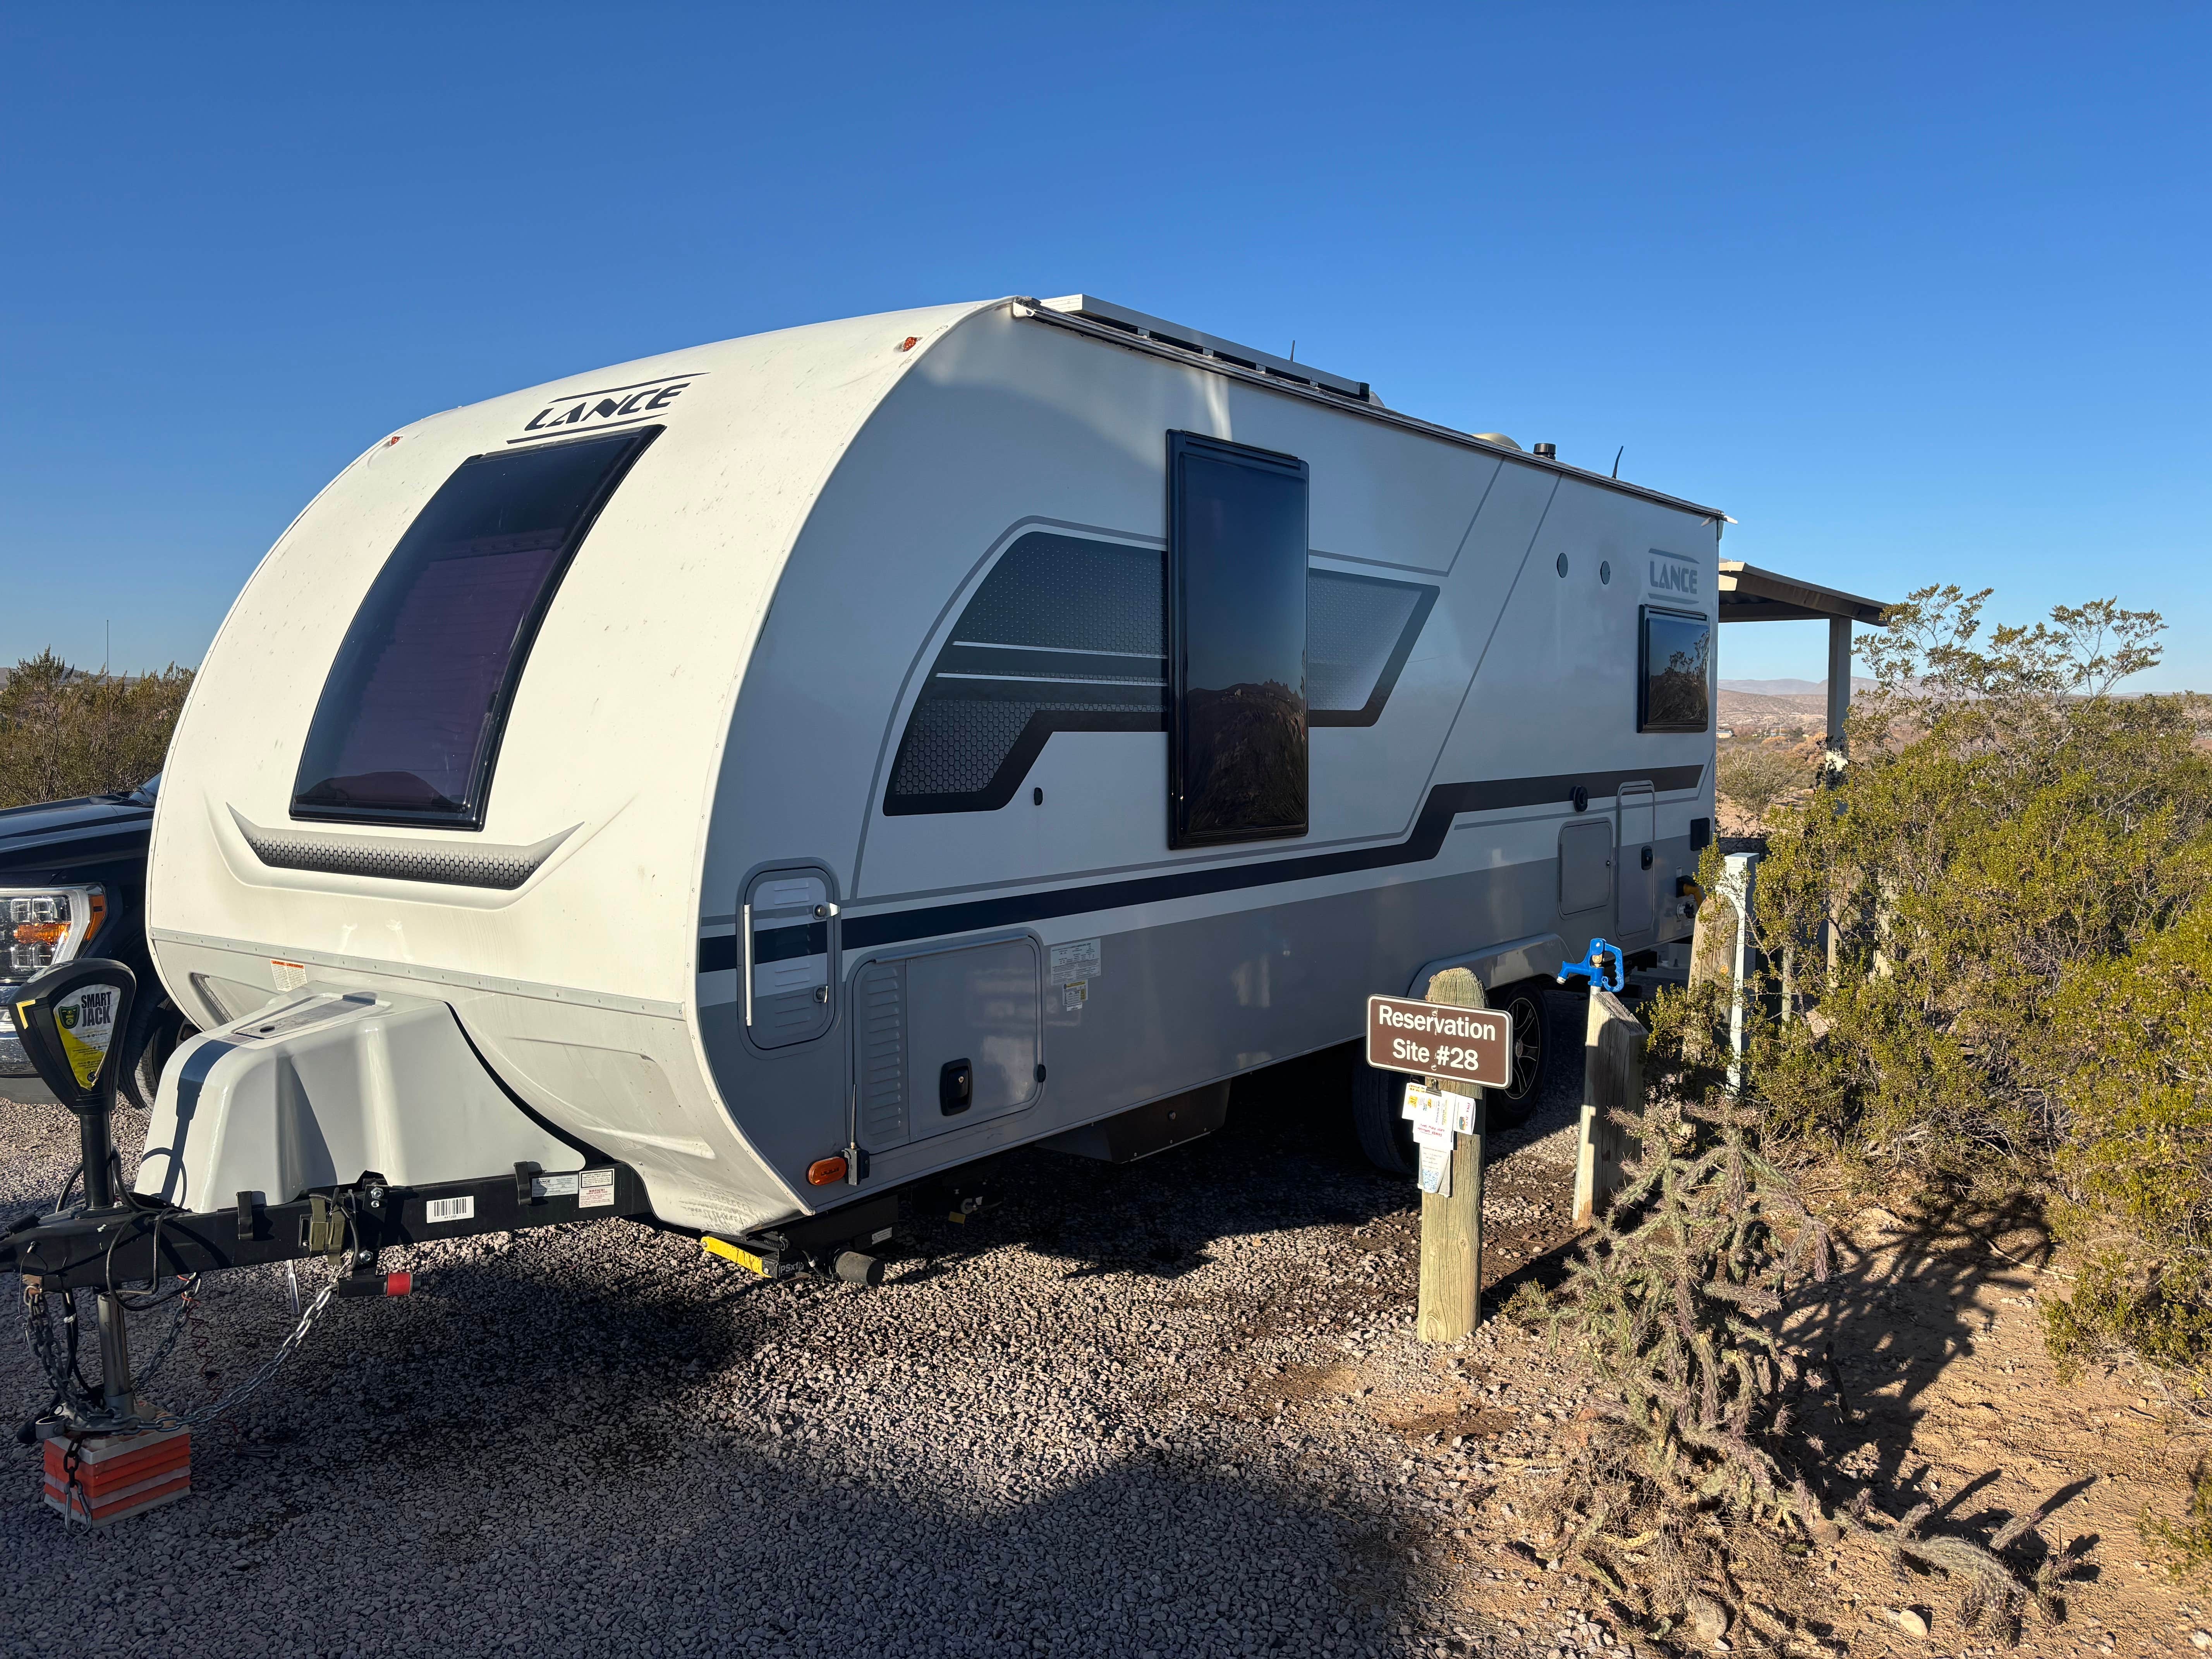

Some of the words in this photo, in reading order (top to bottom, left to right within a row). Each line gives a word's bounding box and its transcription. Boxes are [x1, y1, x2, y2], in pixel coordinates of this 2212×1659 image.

[524, 382, 691, 431] LANCE
[1650, 561, 1697, 594] LANCE
[81, 991, 112, 1009] SMART
[82, 1006, 111, 1027] JACK
[1379, 1005, 1496, 1041] Reservation
[1393, 1038, 1430, 1063] Site
[1436, 1045, 1479, 1071] #28
